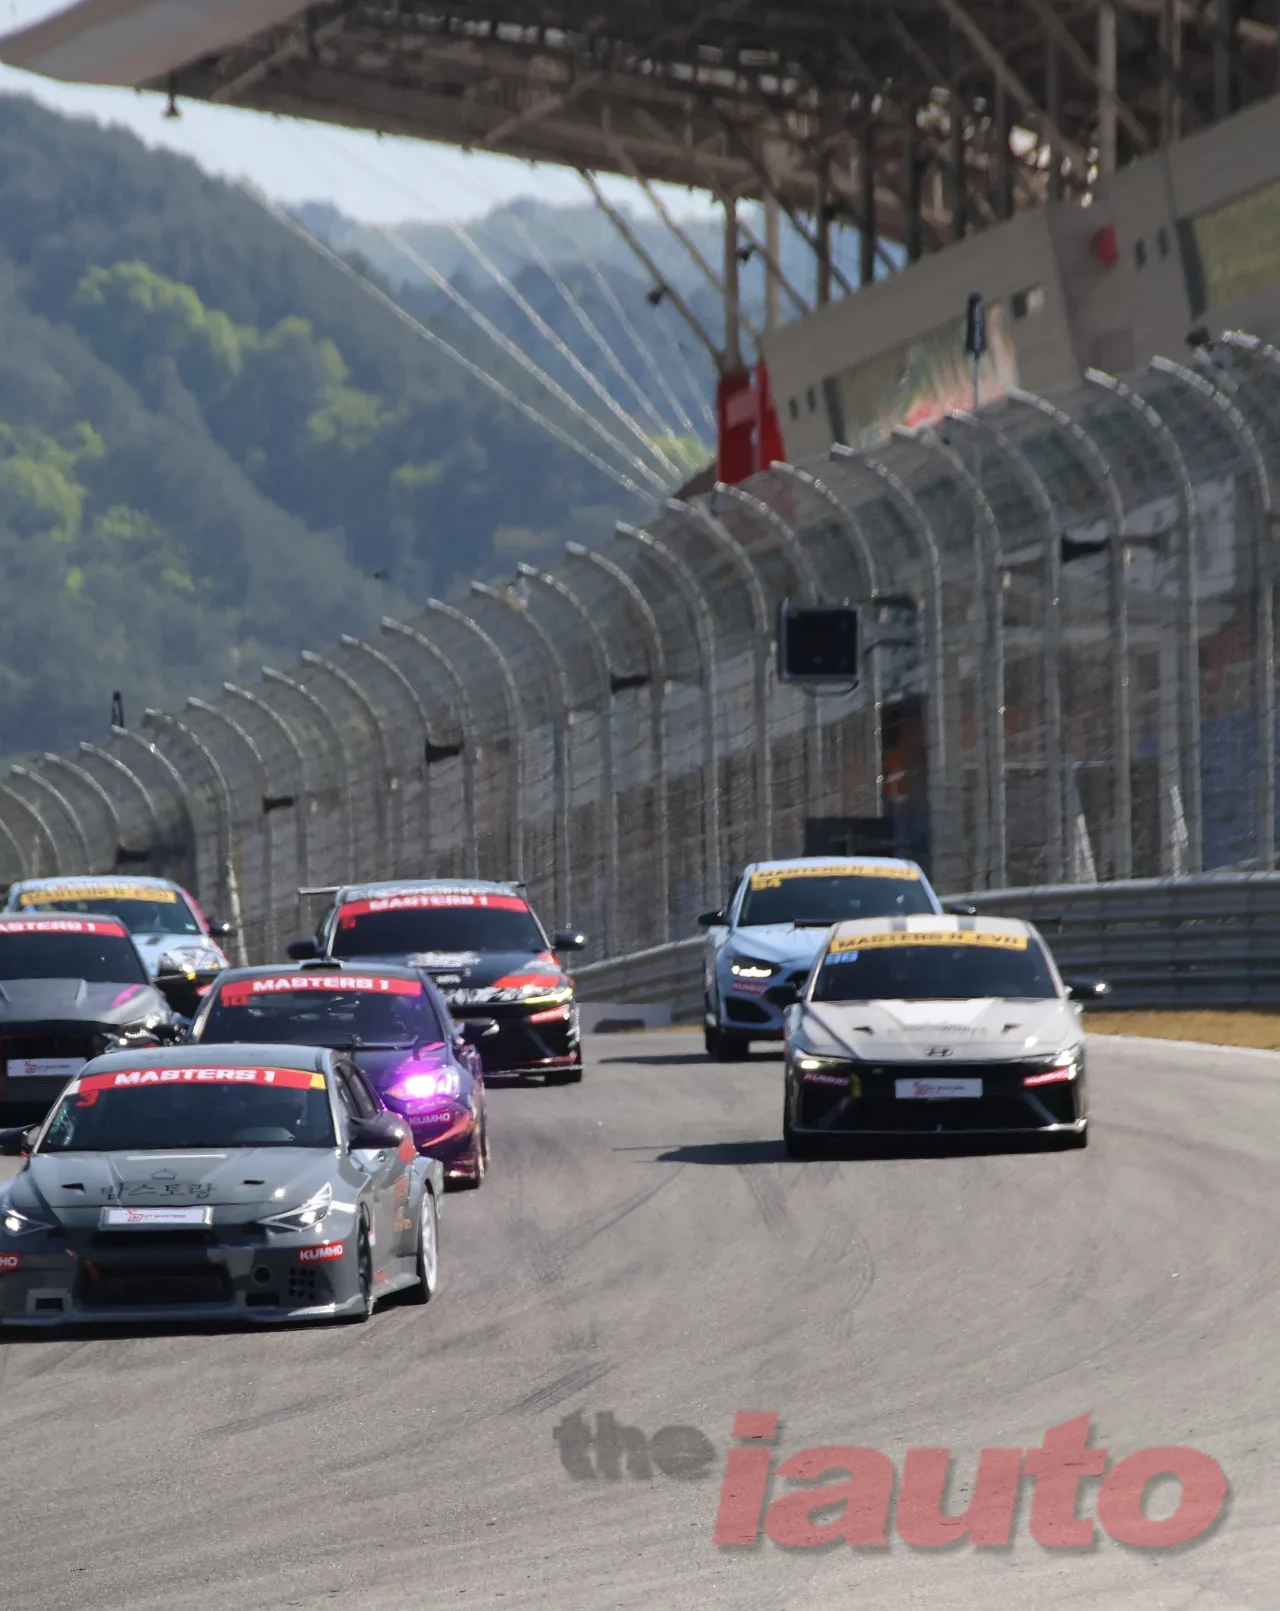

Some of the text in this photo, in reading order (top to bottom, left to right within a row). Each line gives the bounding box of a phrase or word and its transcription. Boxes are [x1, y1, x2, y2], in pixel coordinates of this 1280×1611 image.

[369, 896, 489, 911] MASTERS 1
[86, 922, 97, 932] 1
[838, 932, 944, 948] MASTERS
[975, 933, 1019, 945] EVO
[252, 976, 391, 992] MASTERS 1
[113, 1068, 277, 1085] MASTERS 1
[408, 1112, 451, 1125] KUMHO
[299, 1244, 343, 1261] KUMHO
